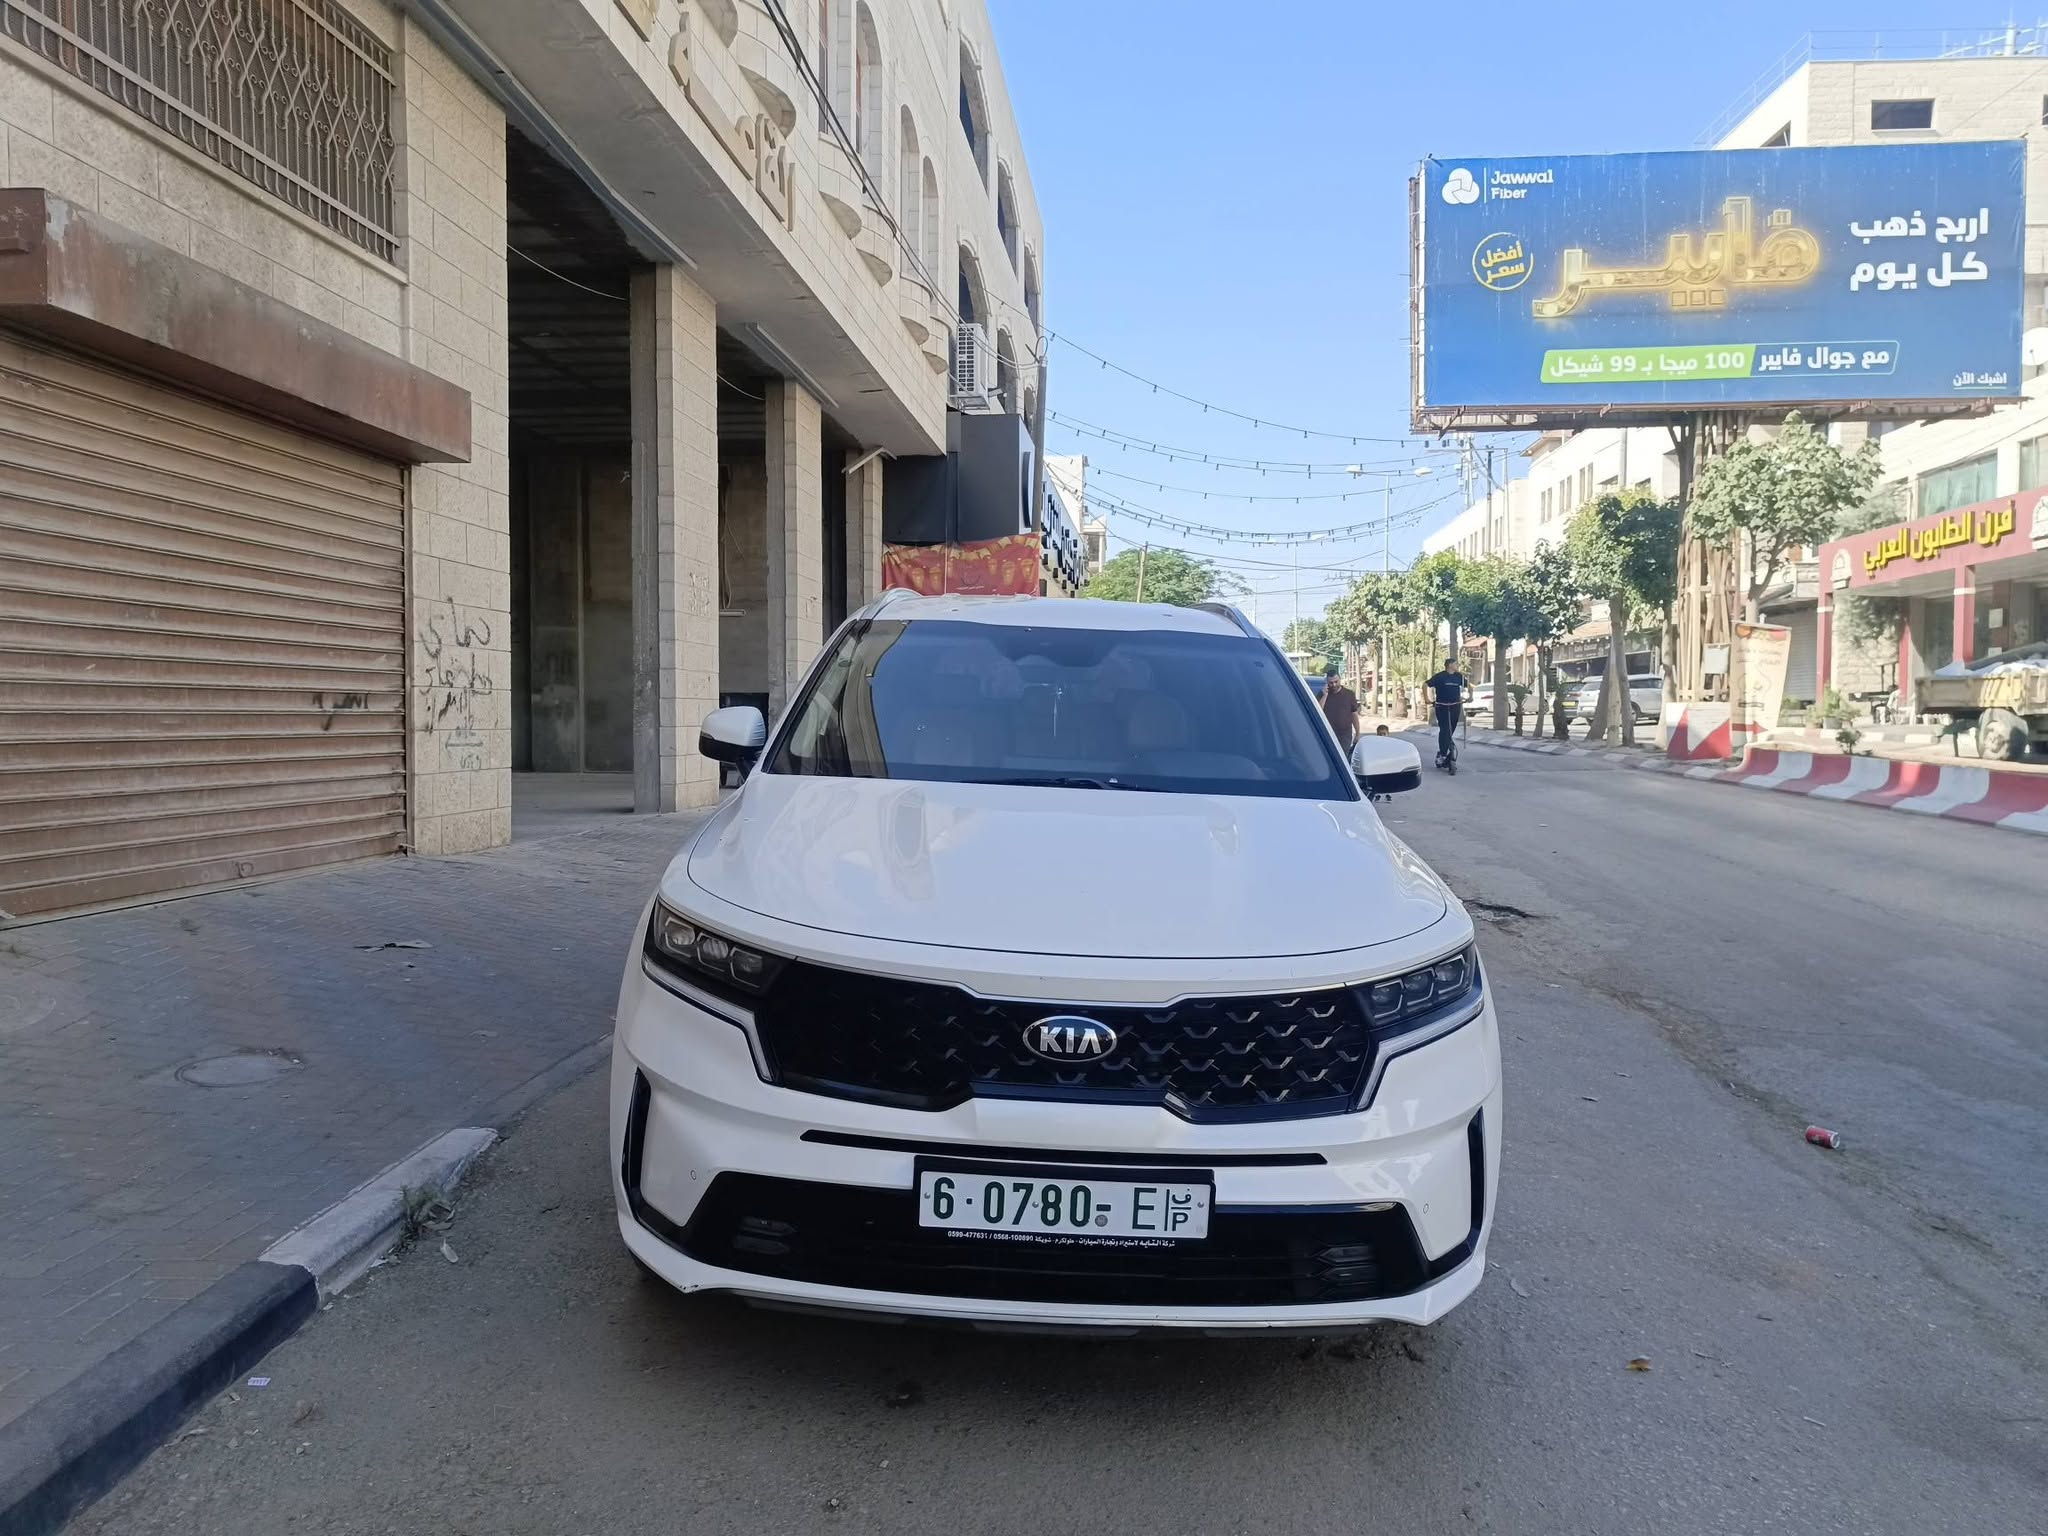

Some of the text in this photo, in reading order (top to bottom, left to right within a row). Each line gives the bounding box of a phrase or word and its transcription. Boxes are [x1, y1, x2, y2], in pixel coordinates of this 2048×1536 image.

[1490, 169, 1554, 185] Jawwal
[1490, 187, 1528, 200] Fiber
[1850, 207, 1989, 245] اربح ذهب
[1481, 240, 1523, 268] أفضل
[1532, 196, 1820, 318] فايبر
[1486, 262, 1525, 285] سعر
[1850, 251, 1988, 292] كل يوم
[1550, 354, 1604, 378] شيكل
[1610, 355, 1637, 372] 99
[1659, 353, 1698, 376] ميجا
[1704, 352, 1745, 370] 100
[1758, 346, 1802, 372] فايبر
[1807, 346, 1856, 370] جوال
[1861, 350, 1890, 369] مع
[1952, 371, 2008, 387] اشبك الآن
[1976, 500, 2015, 546] فرن
[1863, 527, 1909, 578] العربي
[1040, 1026, 1102, 1054] KIA
[1171, 1212, 1189, 1231] P
